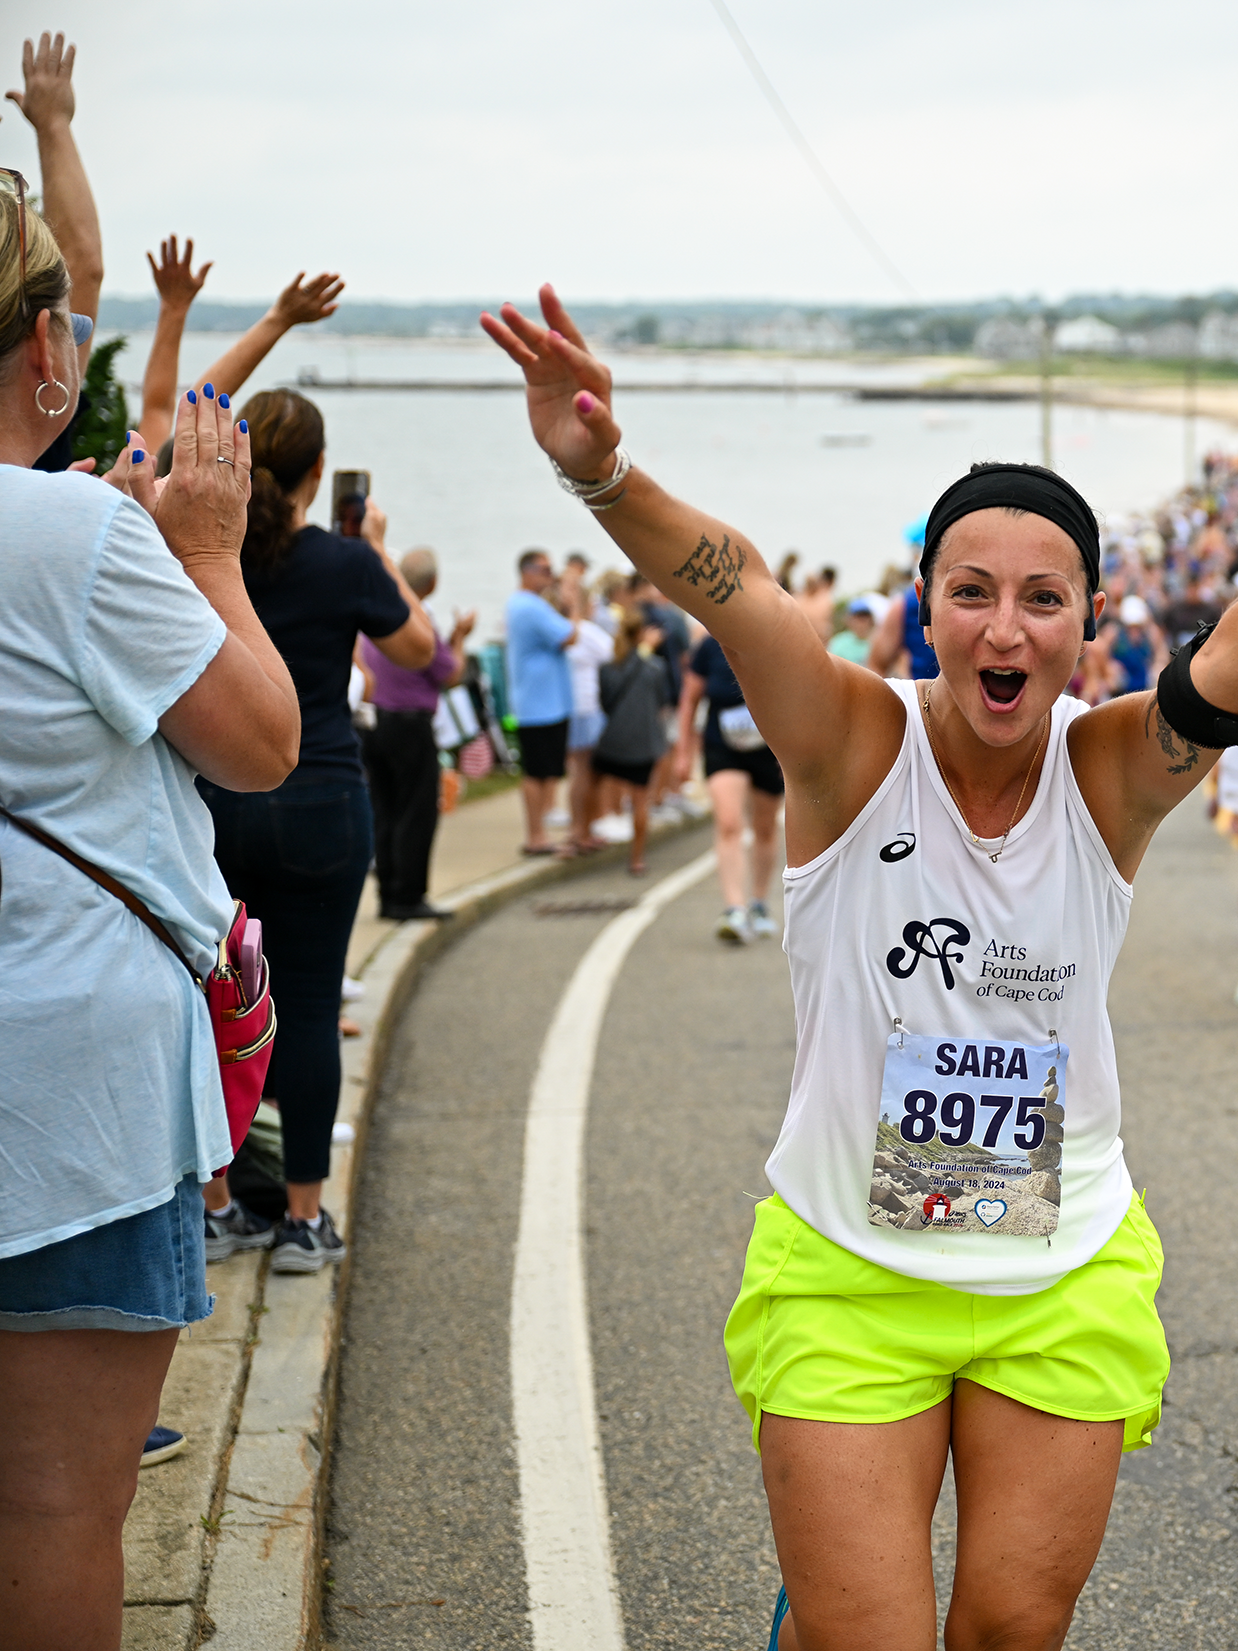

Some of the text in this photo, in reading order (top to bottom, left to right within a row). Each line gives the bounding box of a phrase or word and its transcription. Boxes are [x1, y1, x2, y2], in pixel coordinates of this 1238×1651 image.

[983, 938, 1027, 961] Arts
[976, 982, 1065, 1003] of Cape Cod
[934, 1042, 1029, 1080] SARA
[900, 1089, 1047, 1151] 8975
[908, 1159, 1033, 1176] Arts Foundation of Cape Cod
[933, 1177, 1005, 1190] August 18, 2024
